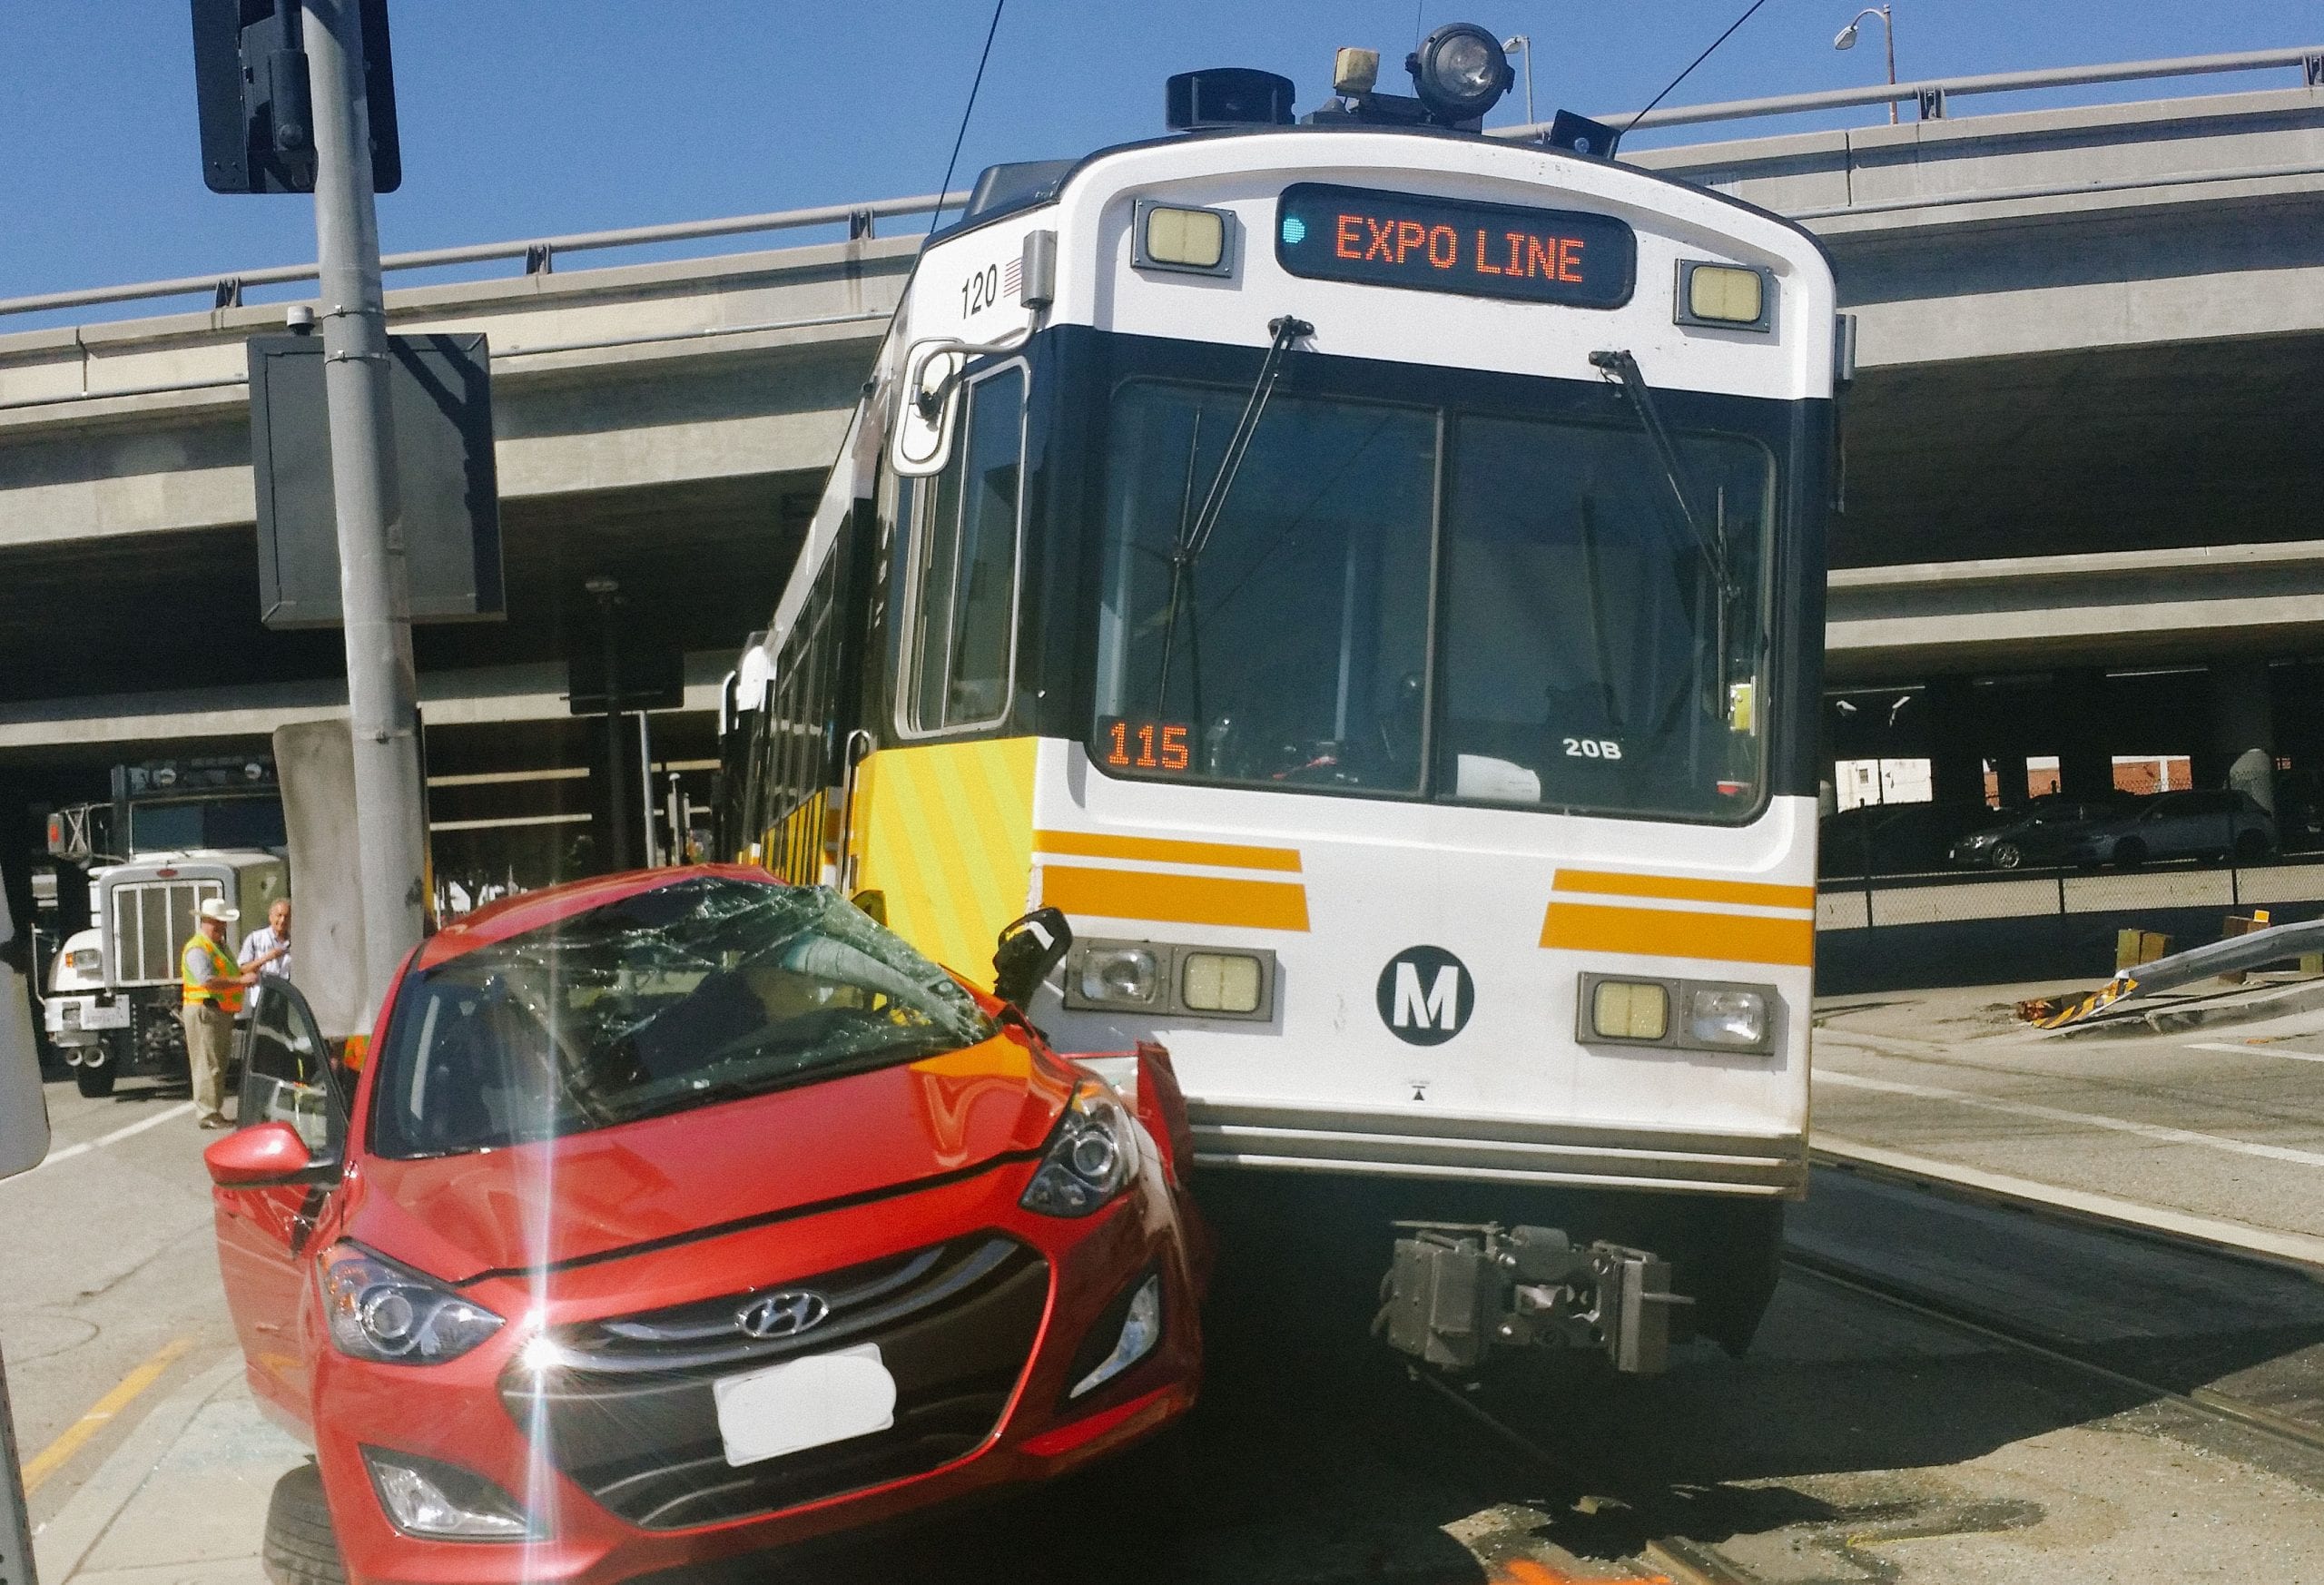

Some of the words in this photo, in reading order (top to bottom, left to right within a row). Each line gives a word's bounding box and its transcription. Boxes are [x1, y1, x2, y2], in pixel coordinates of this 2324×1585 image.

[1336, 214, 1456, 269] EXPO
[1477, 229, 1584, 282] LINE
[961, 263, 997, 320] 120
[1108, 723, 1188, 769] 115
[1562, 737, 1622, 760] 20B
[1393, 961, 1459, 1030] M
